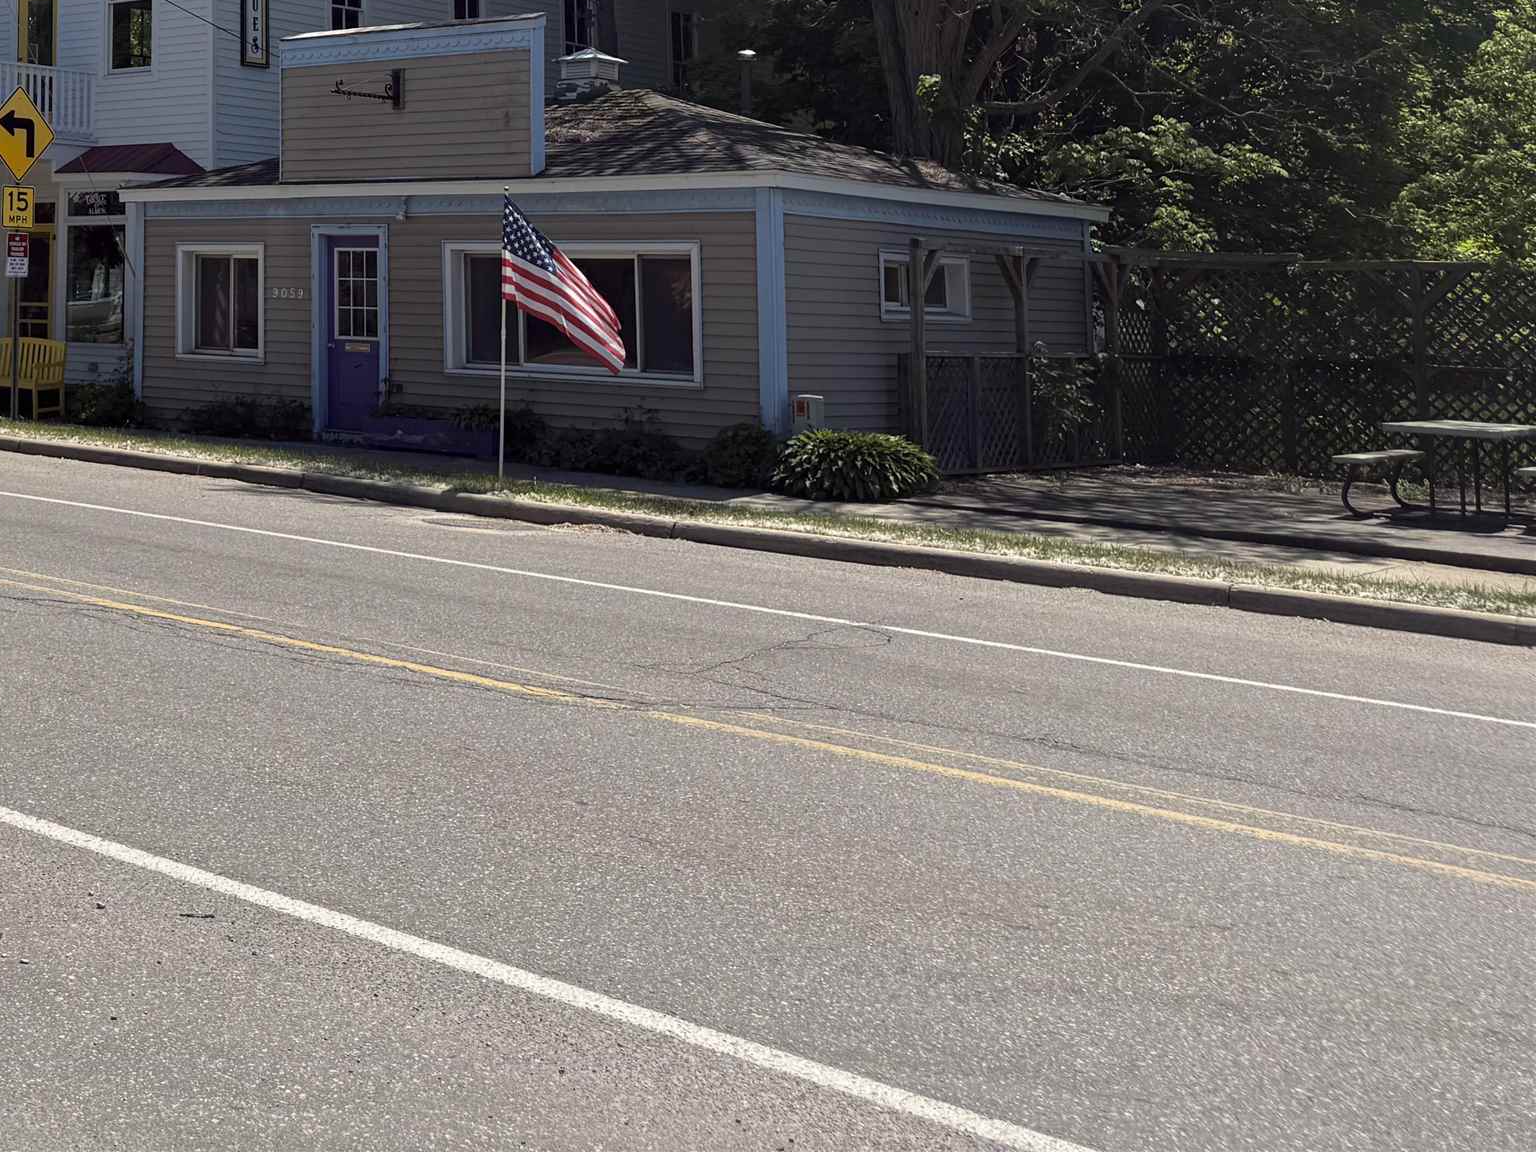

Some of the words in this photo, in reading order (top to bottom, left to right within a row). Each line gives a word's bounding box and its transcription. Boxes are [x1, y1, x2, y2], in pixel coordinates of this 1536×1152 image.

[8, 191, 28, 212] 15
[8, 216, 28, 224] MPH
[272, 287, 304, 299] 9059
